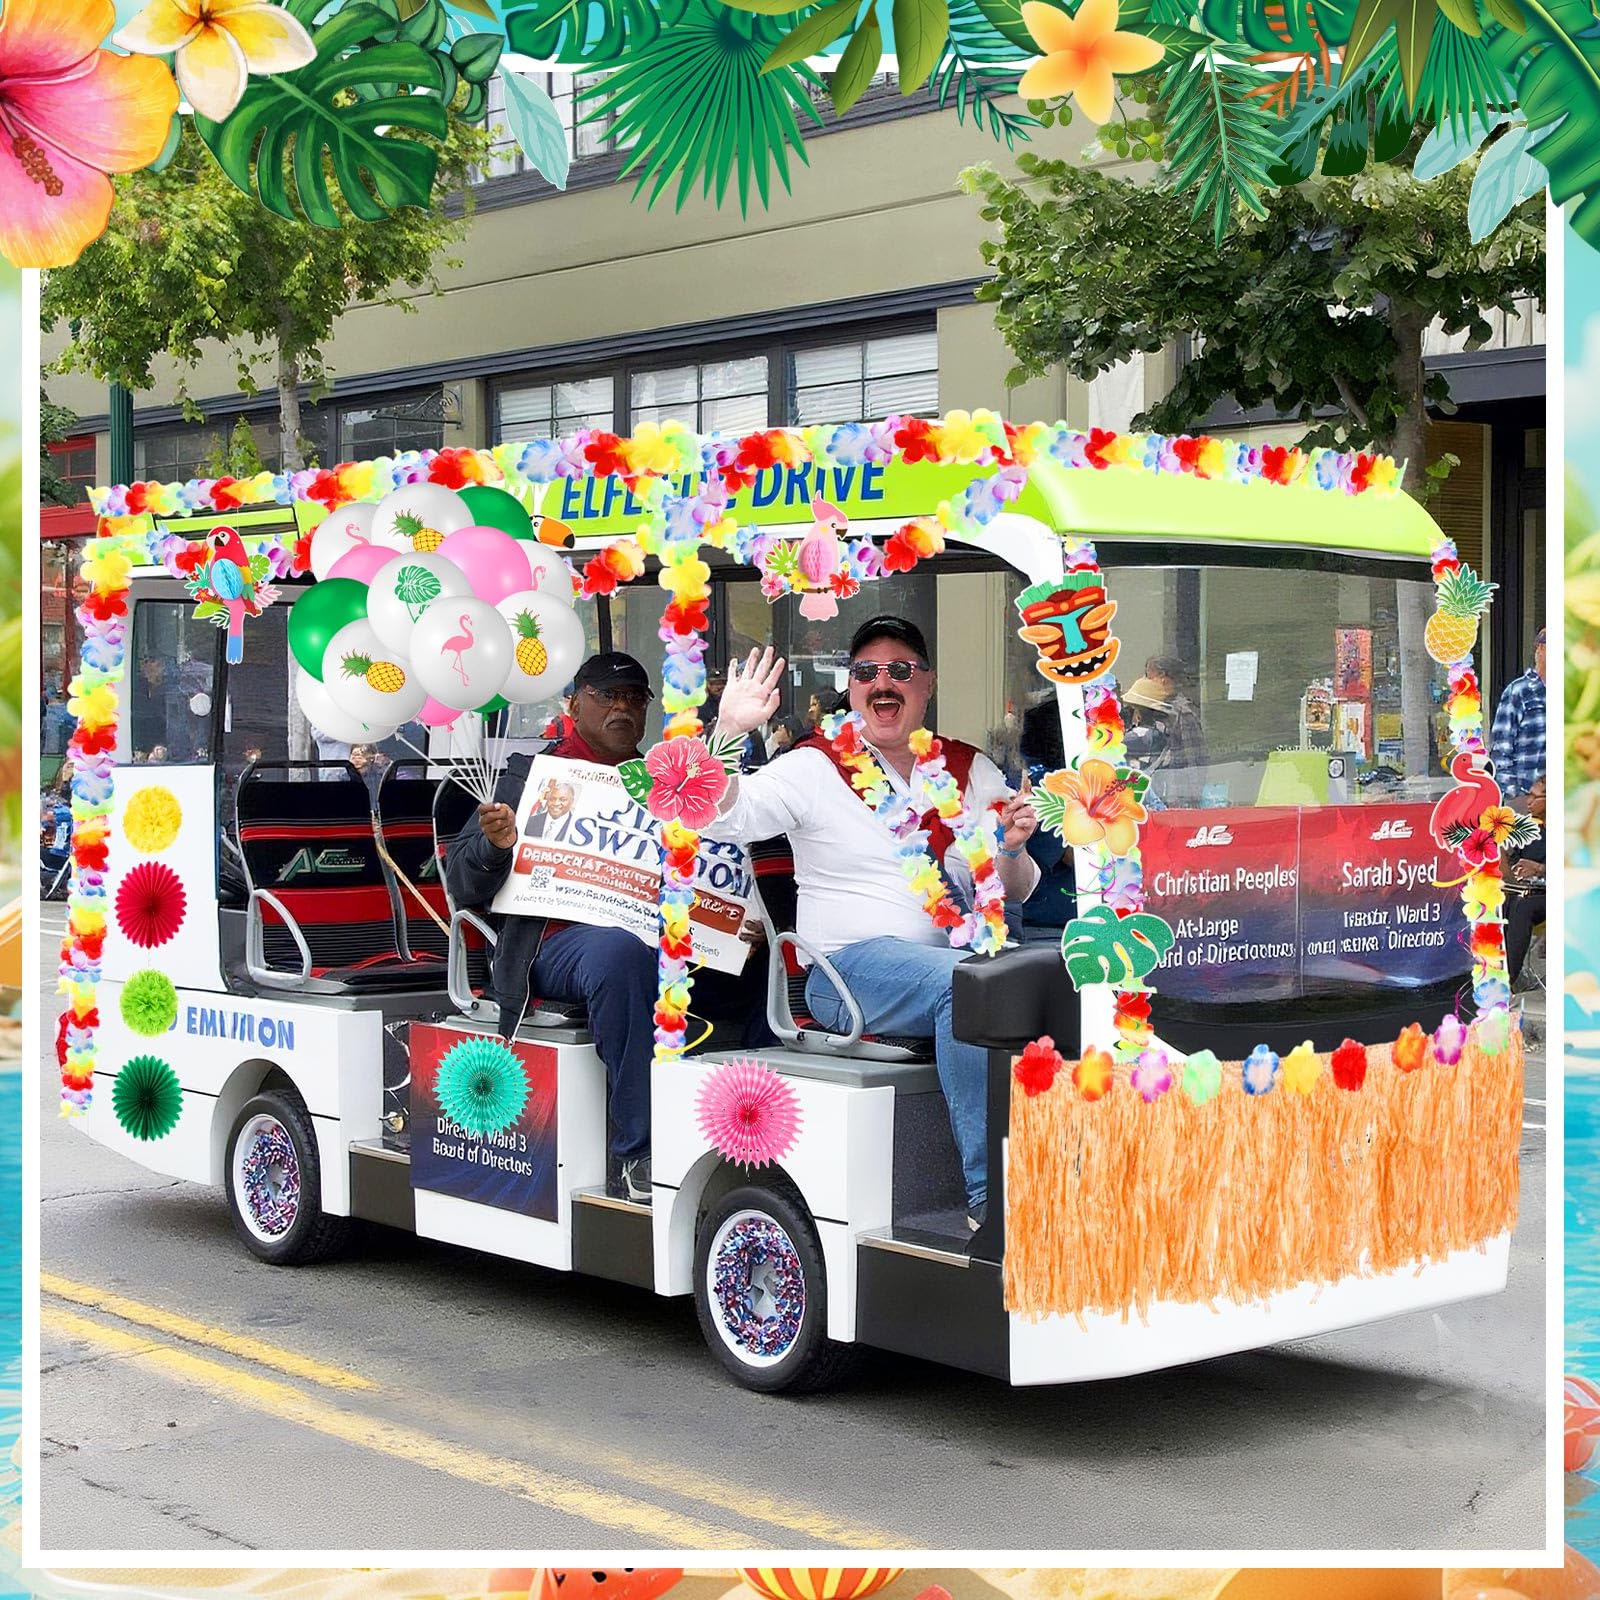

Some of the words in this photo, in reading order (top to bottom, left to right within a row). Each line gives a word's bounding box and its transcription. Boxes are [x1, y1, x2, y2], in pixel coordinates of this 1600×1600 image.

[752, 460, 885, 507] DRIVE
[1153, 868, 1231, 897] Christian
[1235, 863, 1297, 895] Peeples
[1342, 857, 1393, 888] Sarah
[1397, 855, 1438, 891] Syed
[1396, 902, 1429, 924] Ward
[1432, 902, 1441, 922] 3
[1175, 916, 1240, 941] At-Large
[1388, 930, 1446, 950] Directors
[519, 1133, 527, 1152] 3
[467, 1145, 480, 1163] of
[482, 1148, 532, 1176] Directors
